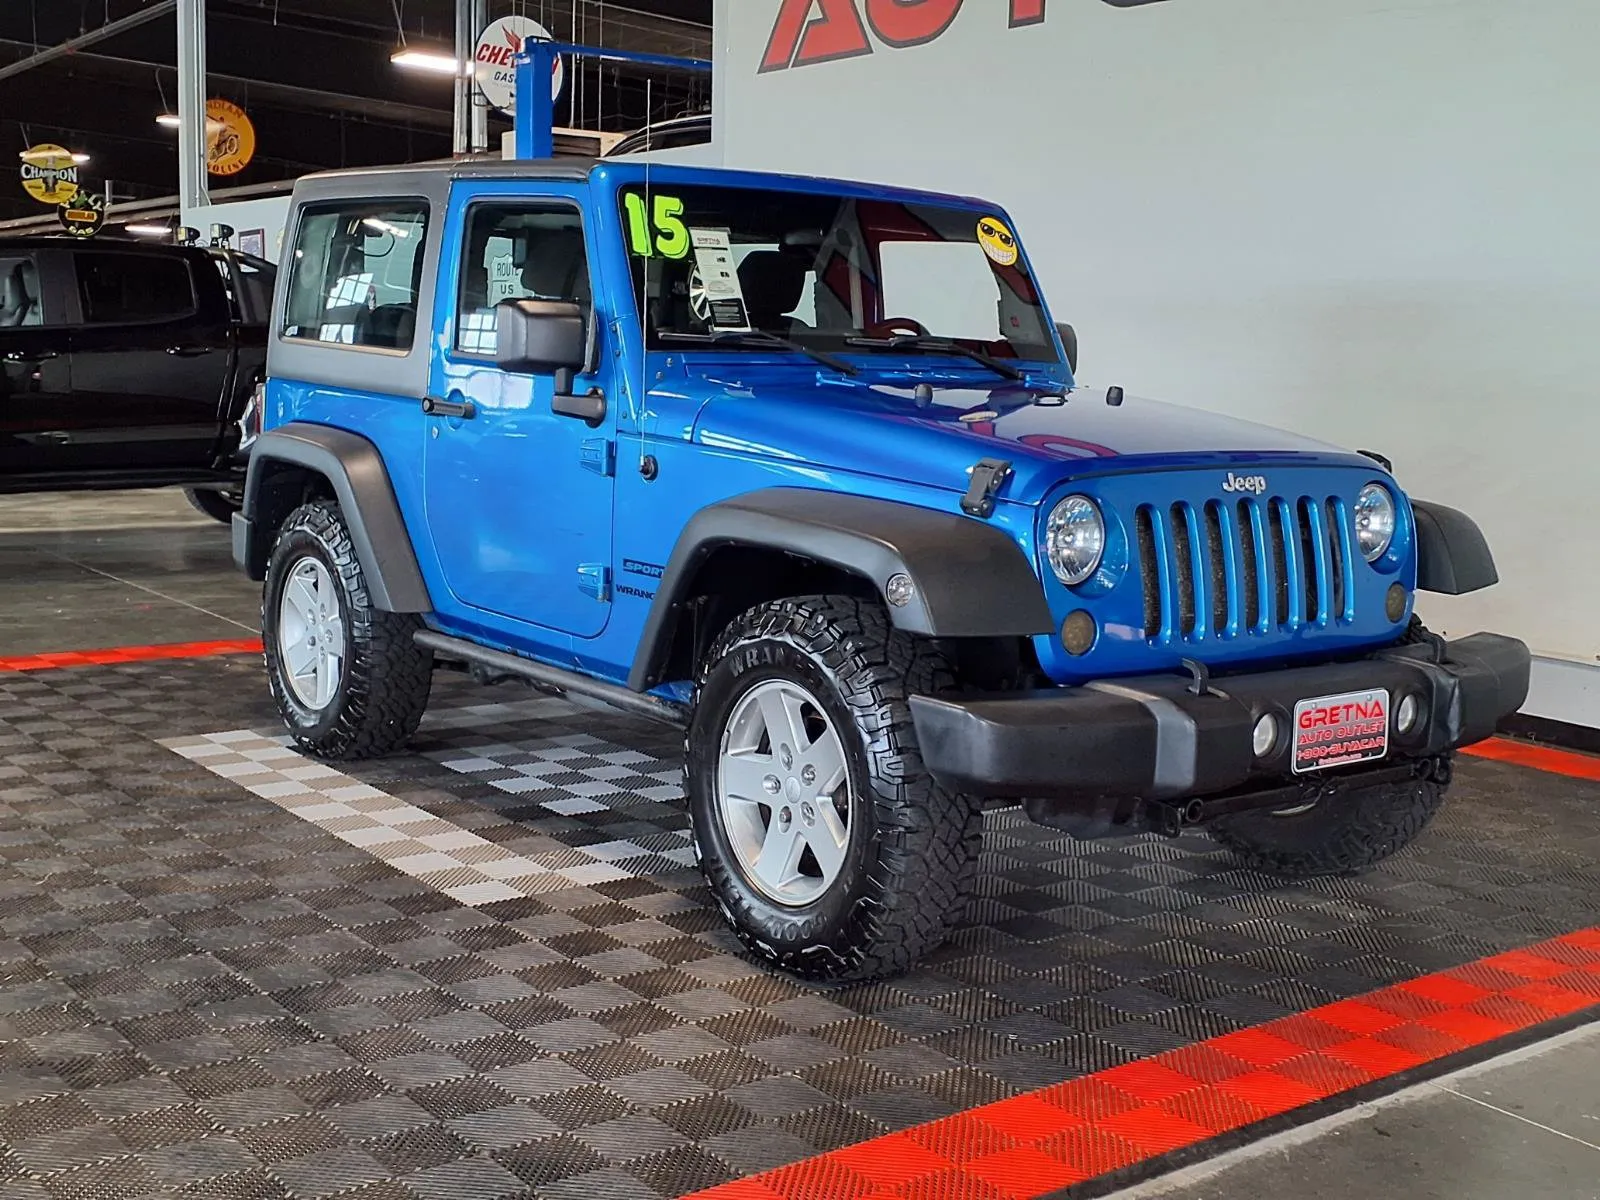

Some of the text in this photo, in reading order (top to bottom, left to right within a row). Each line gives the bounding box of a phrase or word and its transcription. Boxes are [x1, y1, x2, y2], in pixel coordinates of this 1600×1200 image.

[21, 163, 79, 183] CHAMPION
[624, 192, 690, 260] 15
[500, 283, 514, 295] US
[1222, 472, 1267, 495] Jeep
[616, 584, 656, 601] WRANG
[1299, 700, 1385, 729] GRETNA
[1298, 720, 1385, 745] AUTO OUTLET
